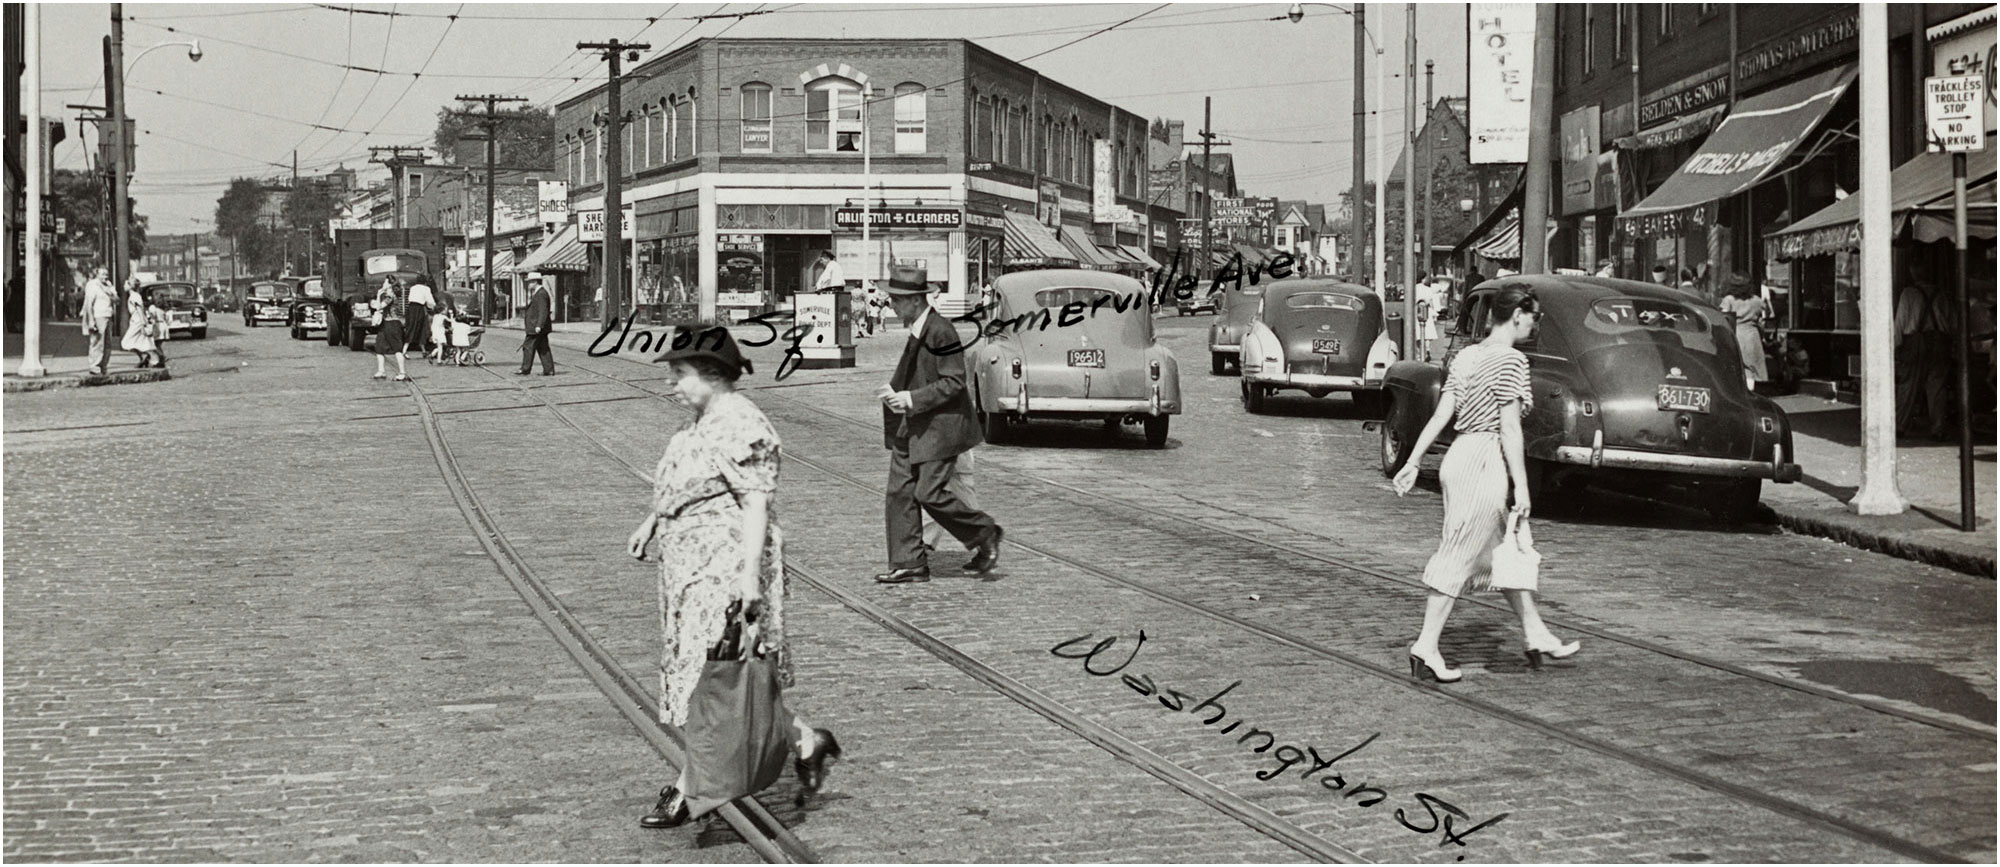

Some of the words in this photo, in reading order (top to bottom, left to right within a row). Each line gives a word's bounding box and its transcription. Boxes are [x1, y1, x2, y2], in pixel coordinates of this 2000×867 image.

[1479, 17, 1525, 103] HOTEL
[1738, 44, 1783, 80] THOMAS
[1929, 80, 1982, 93] TRACKLESS
[1641, 92, 1683, 124] BELDEN
[1683, 91, 1694, 108] &
[1694, 77, 1728, 106] SNOW
[1935, 92, 1976, 104] TROLLEY
[1943, 104, 1967, 114] STOP
[1948, 123, 1963, 133] NO
[745, 134, 768, 142] LAWYER
[1939, 135, 1977, 148] ARKING
[540, 200, 566, 212] SHOES
[1217, 208, 1254, 216] NATIONAL
[586, 212, 626, 223] SHEN
[837, 212, 892, 224] ARLINGTON
[905, 212, 960, 224] CLEANERS
[1217, 216, 1249, 225] STORES
[1644, 212, 1683, 235] BAKERY
[799, 305, 831, 316] SOMERVILLE
